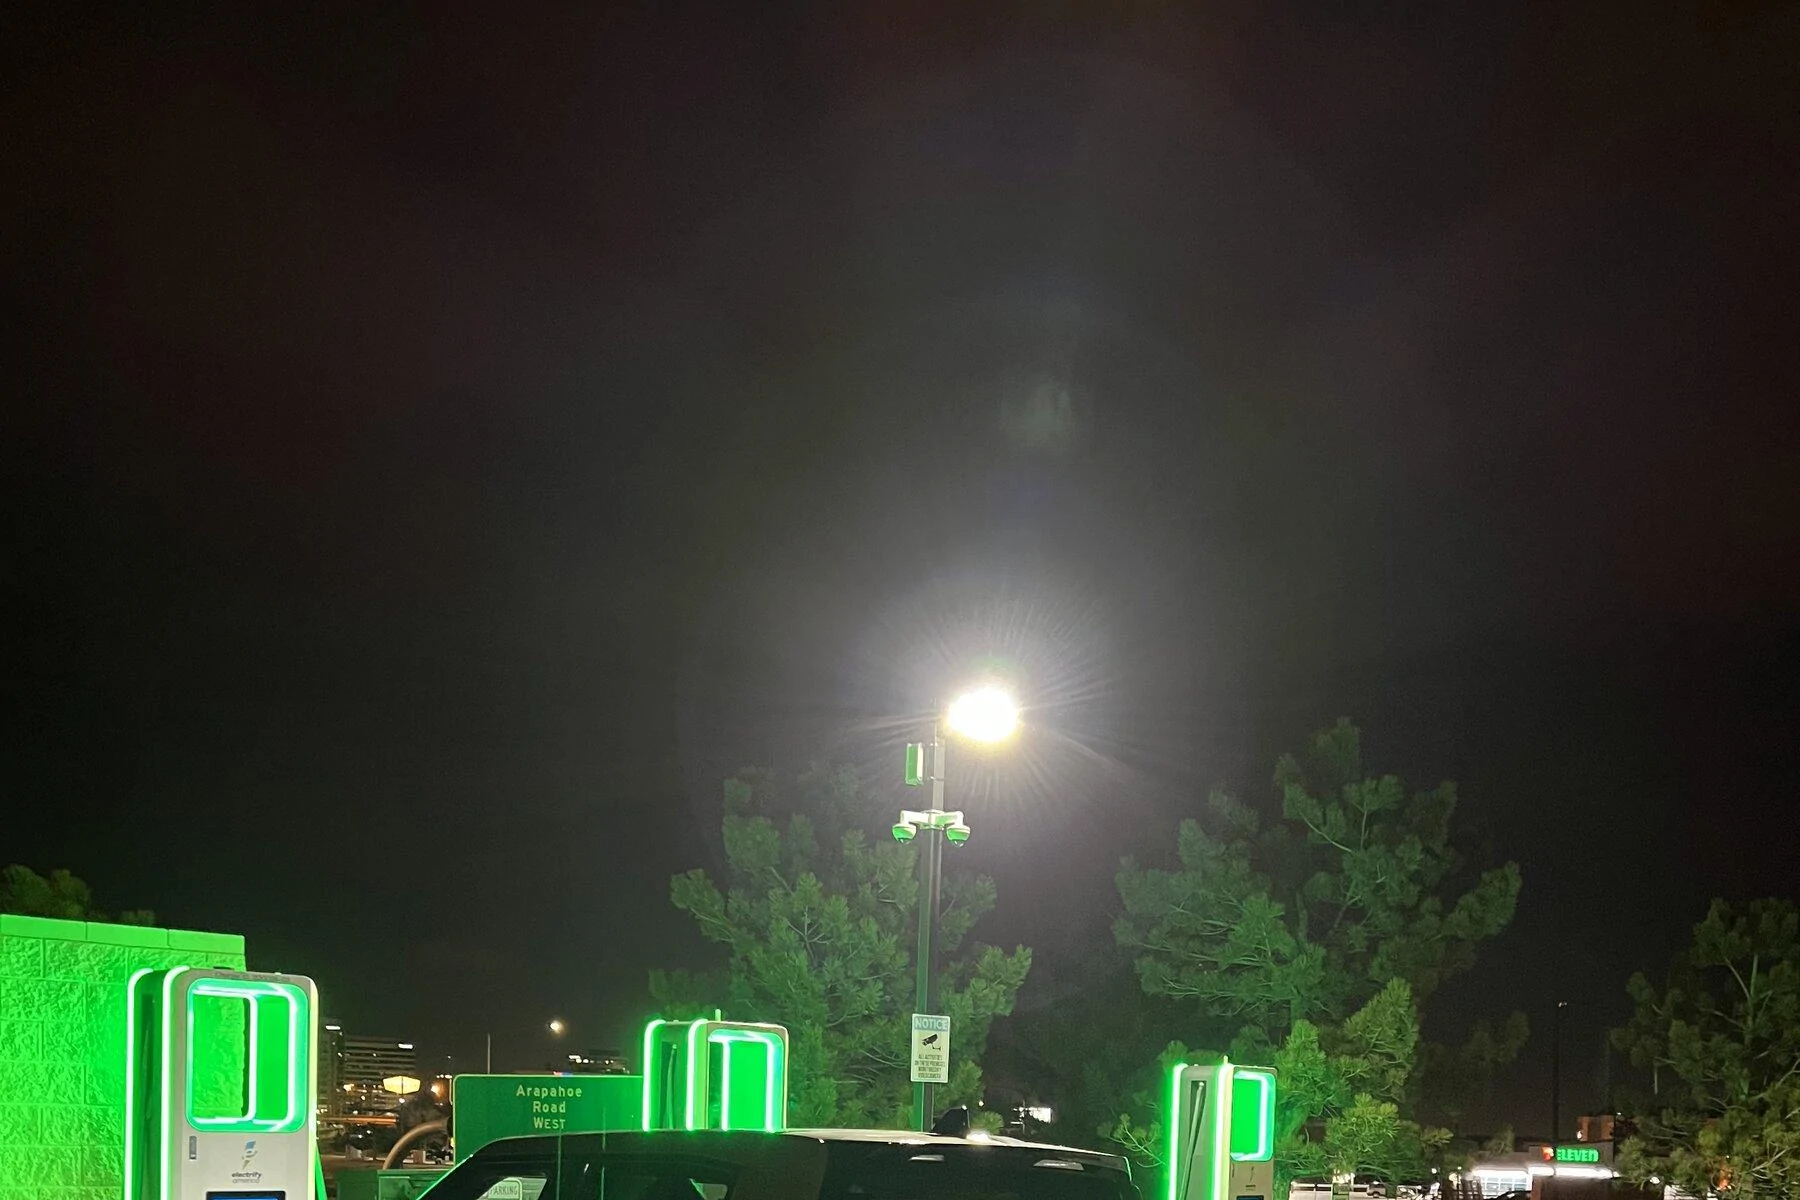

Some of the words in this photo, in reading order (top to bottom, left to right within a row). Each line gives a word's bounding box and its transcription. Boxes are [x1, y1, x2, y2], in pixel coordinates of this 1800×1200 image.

[915, 1017, 948, 1030] NOTICE
[516, 1084, 582, 1099] Arapahoe
[533, 1100, 566, 1113] Road
[533, 1116, 566, 1129] WEST
